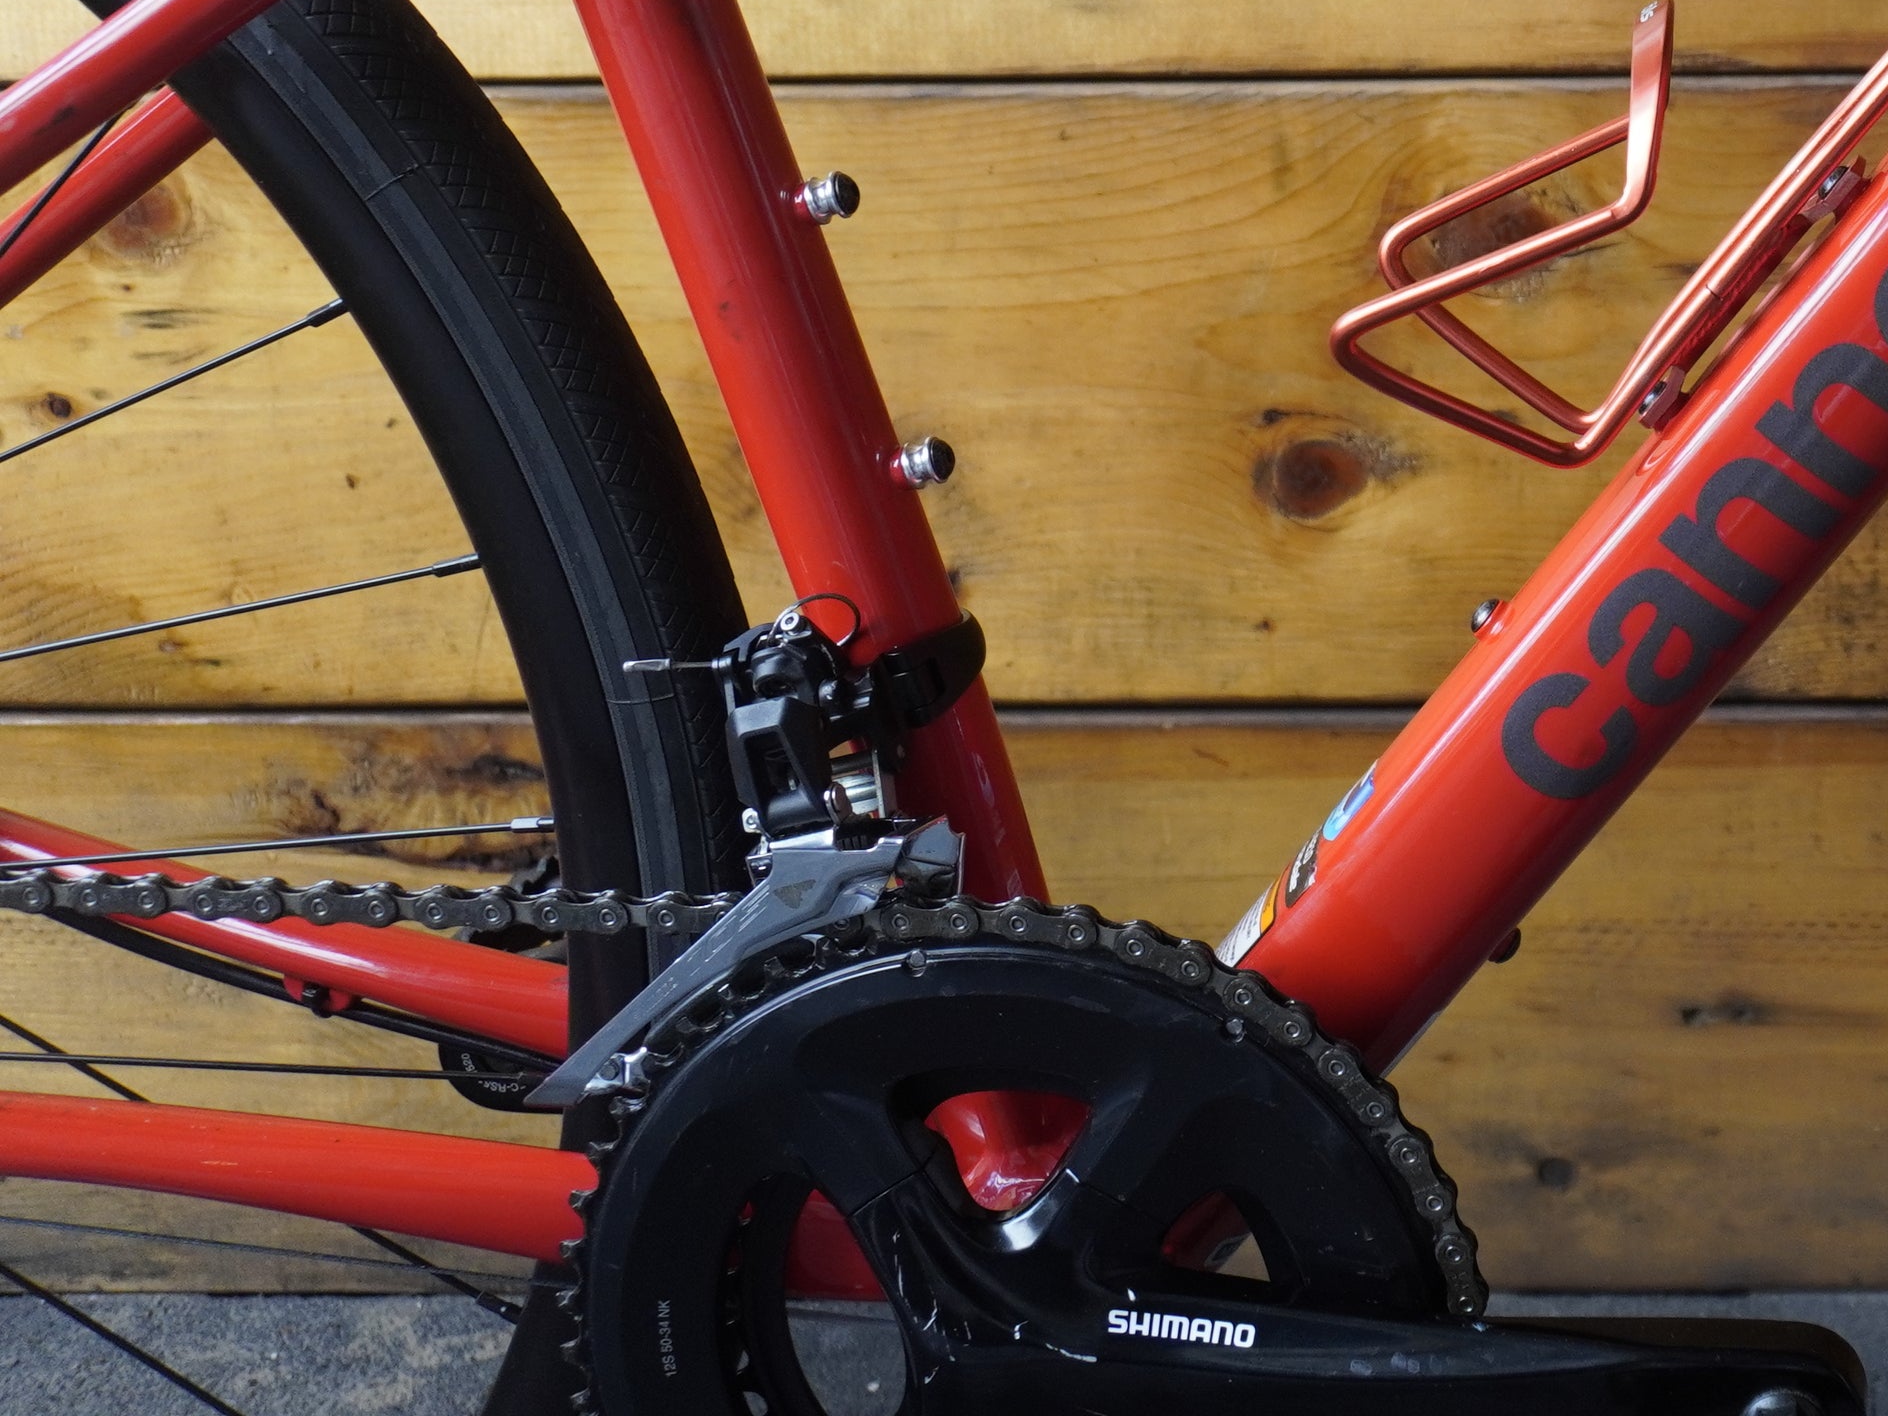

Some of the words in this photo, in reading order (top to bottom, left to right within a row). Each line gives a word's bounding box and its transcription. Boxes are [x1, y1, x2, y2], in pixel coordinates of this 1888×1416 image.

[657, 1299, 671, 1318] NK
[659, 1320, 673, 1353] 50-34
[1107, 1309, 1256, 1349] SHIMANO
[662, 1354, 678, 1377] 12S
